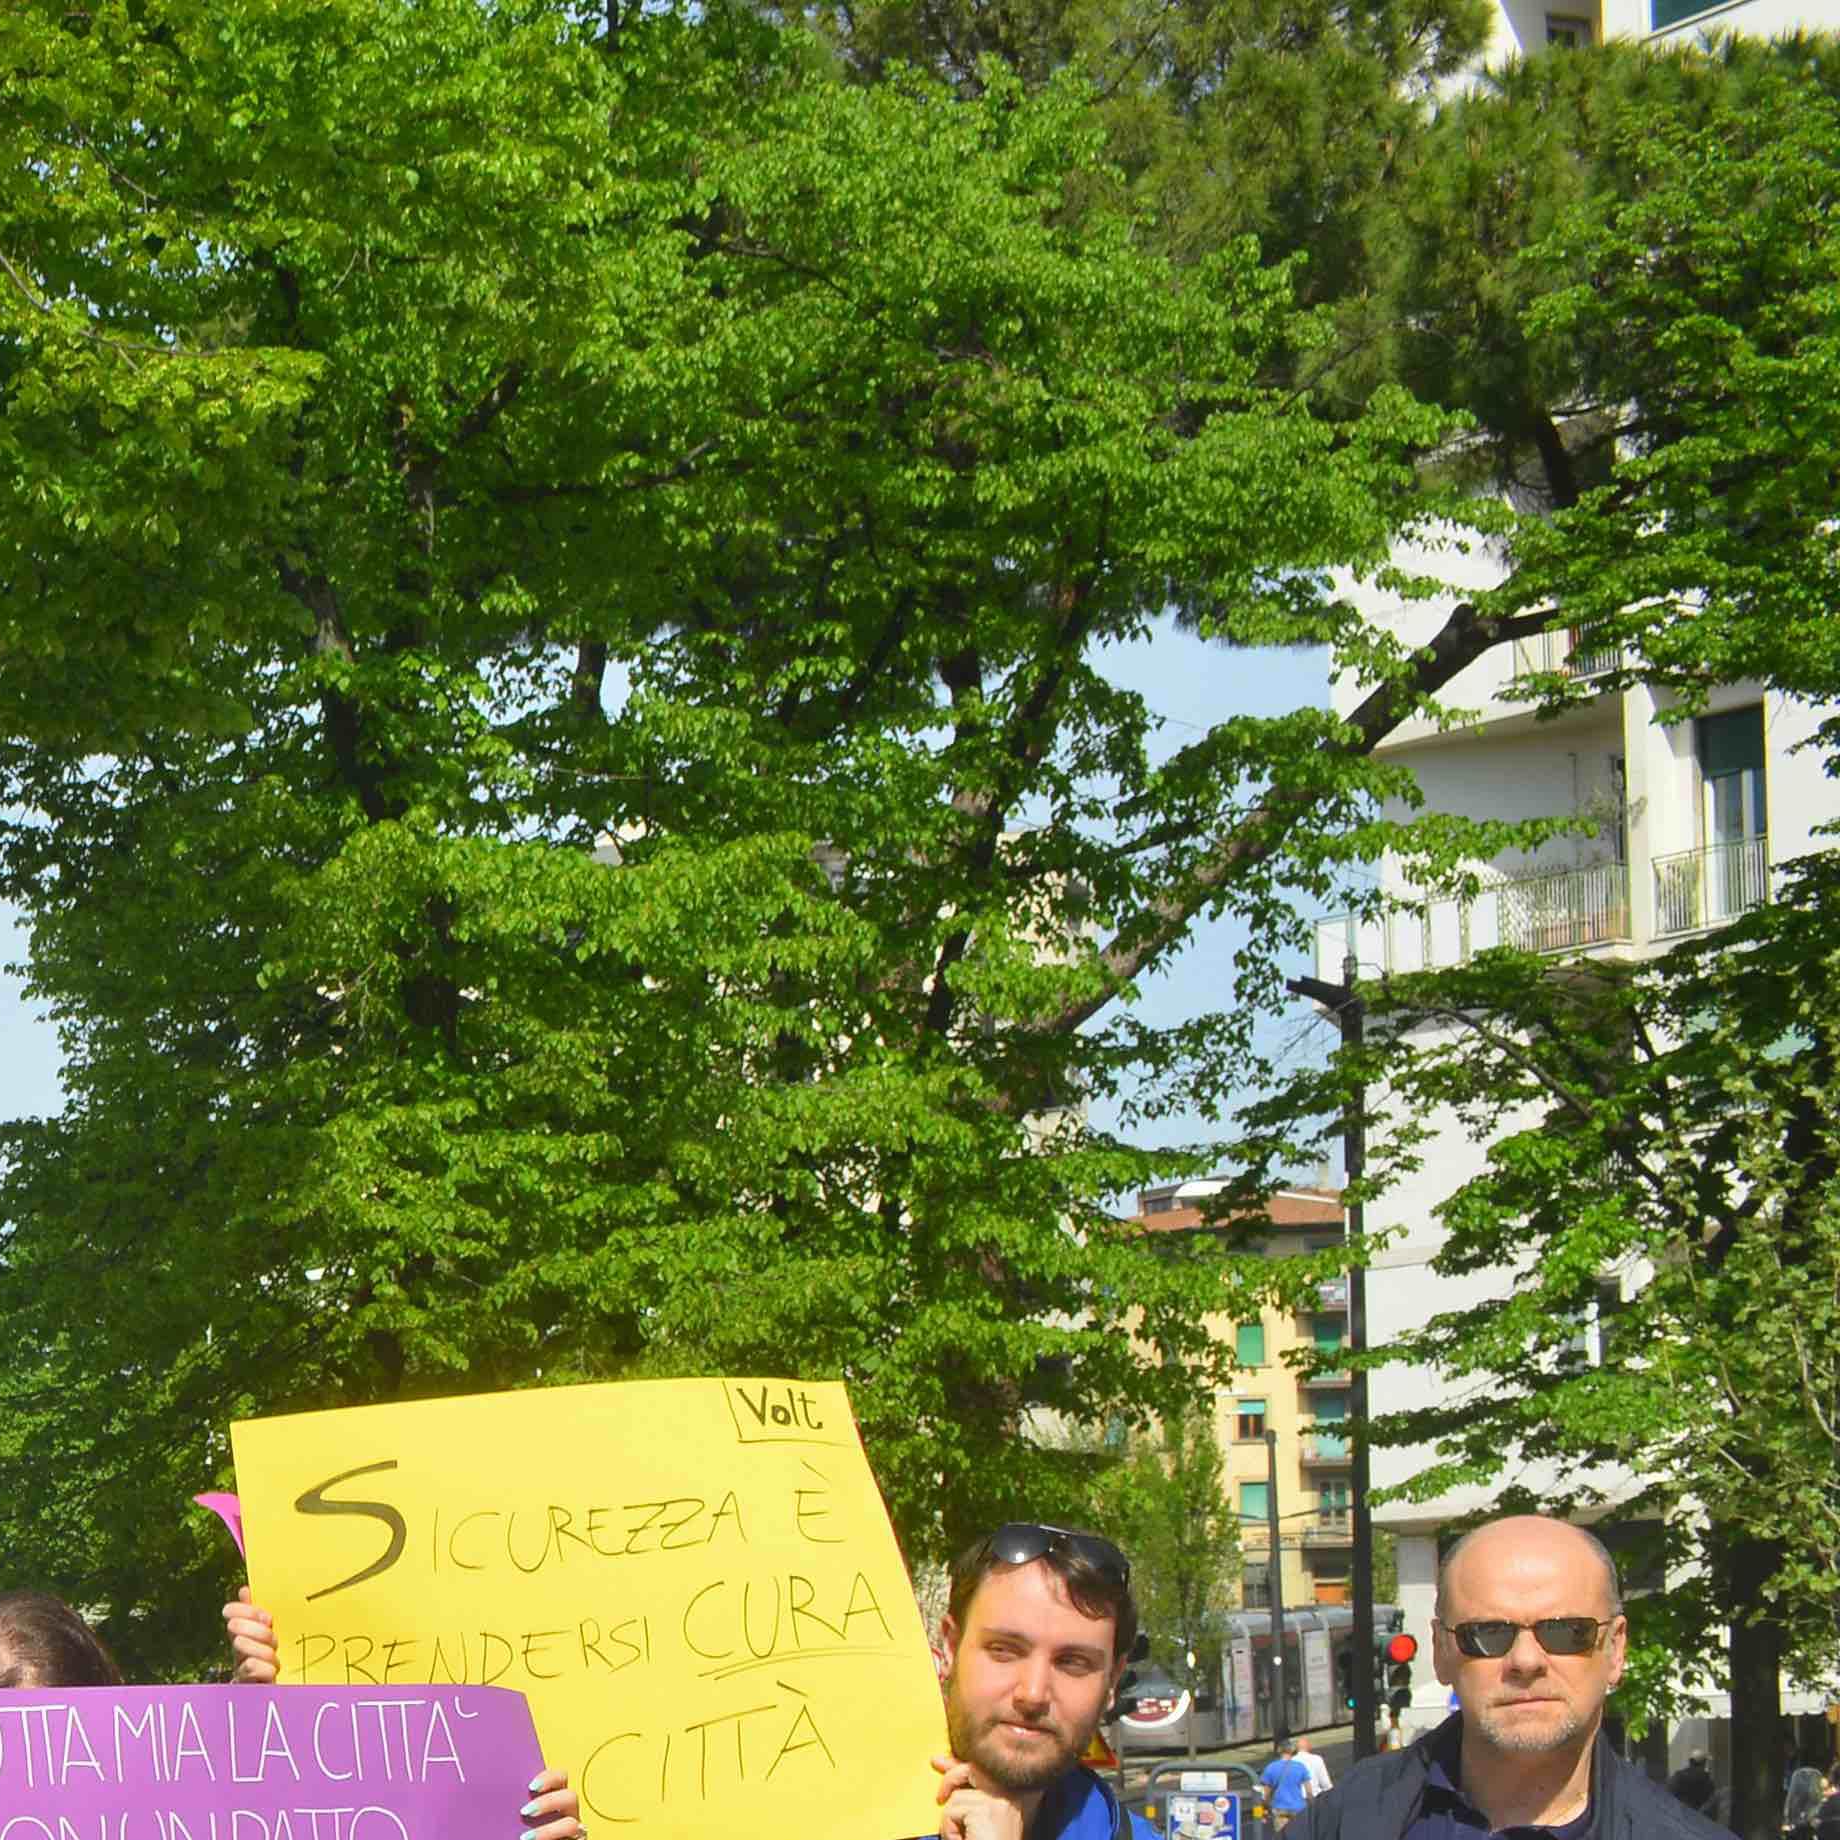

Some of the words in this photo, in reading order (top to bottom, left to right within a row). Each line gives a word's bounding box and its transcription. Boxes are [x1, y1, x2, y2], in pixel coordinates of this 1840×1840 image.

[736, 1384, 824, 1430] Volt
[294, 1459, 747, 1601] SICUREZZA
[684, 1571, 894, 1662] CURA
[113, 1702, 216, 1783] MIA
[227, 1700, 300, 1784] LA
[581, 1681, 836, 1823] CITTÀ
